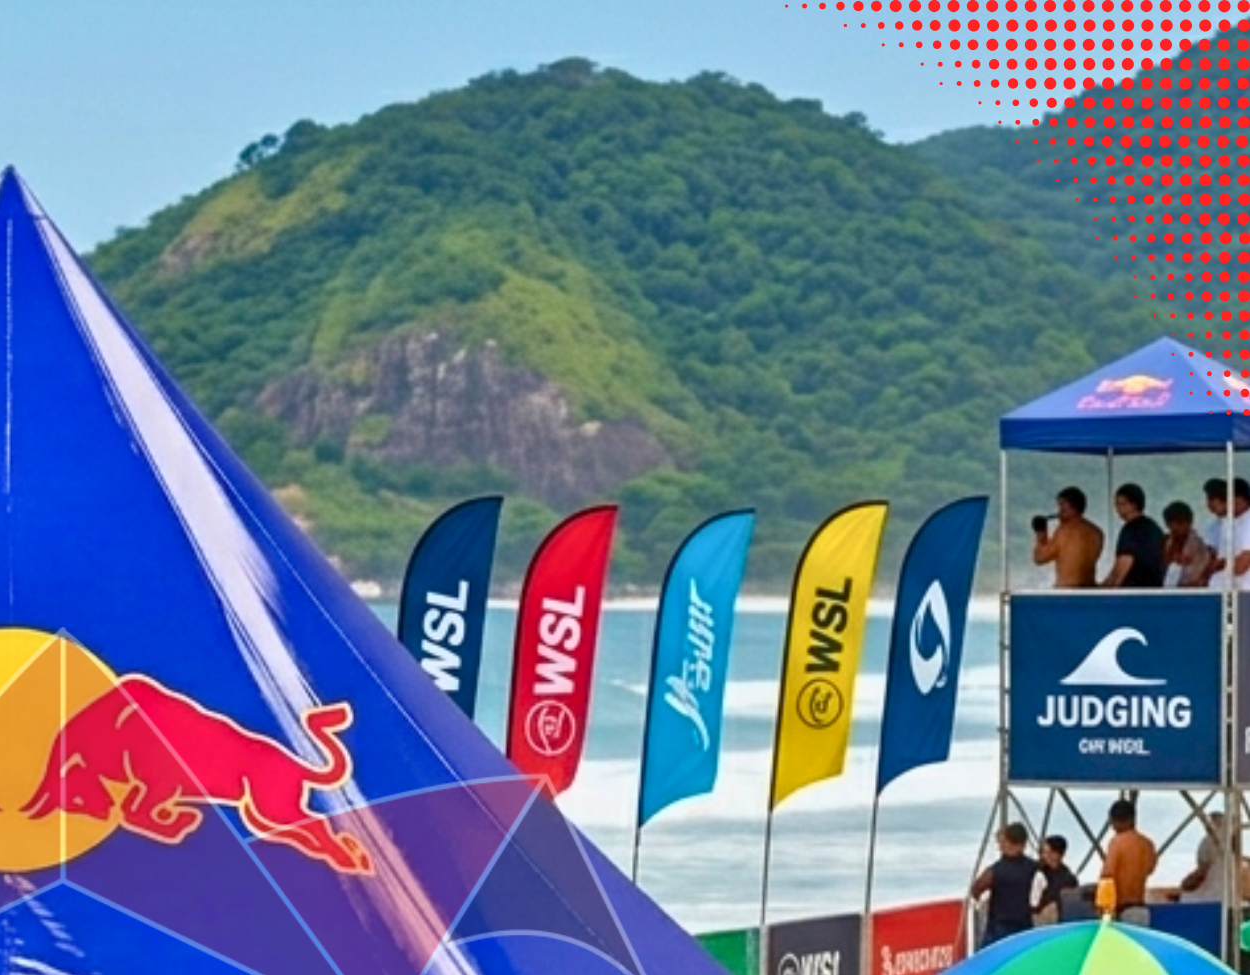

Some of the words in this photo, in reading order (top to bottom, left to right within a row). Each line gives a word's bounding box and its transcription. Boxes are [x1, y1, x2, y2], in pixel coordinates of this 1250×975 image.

[420, 579, 470, 692] WSL
[533, 585, 587, 696] WSL
[805, 576, 854, 674] WSL
[1036, 694, 1192, 729] JUDGING
